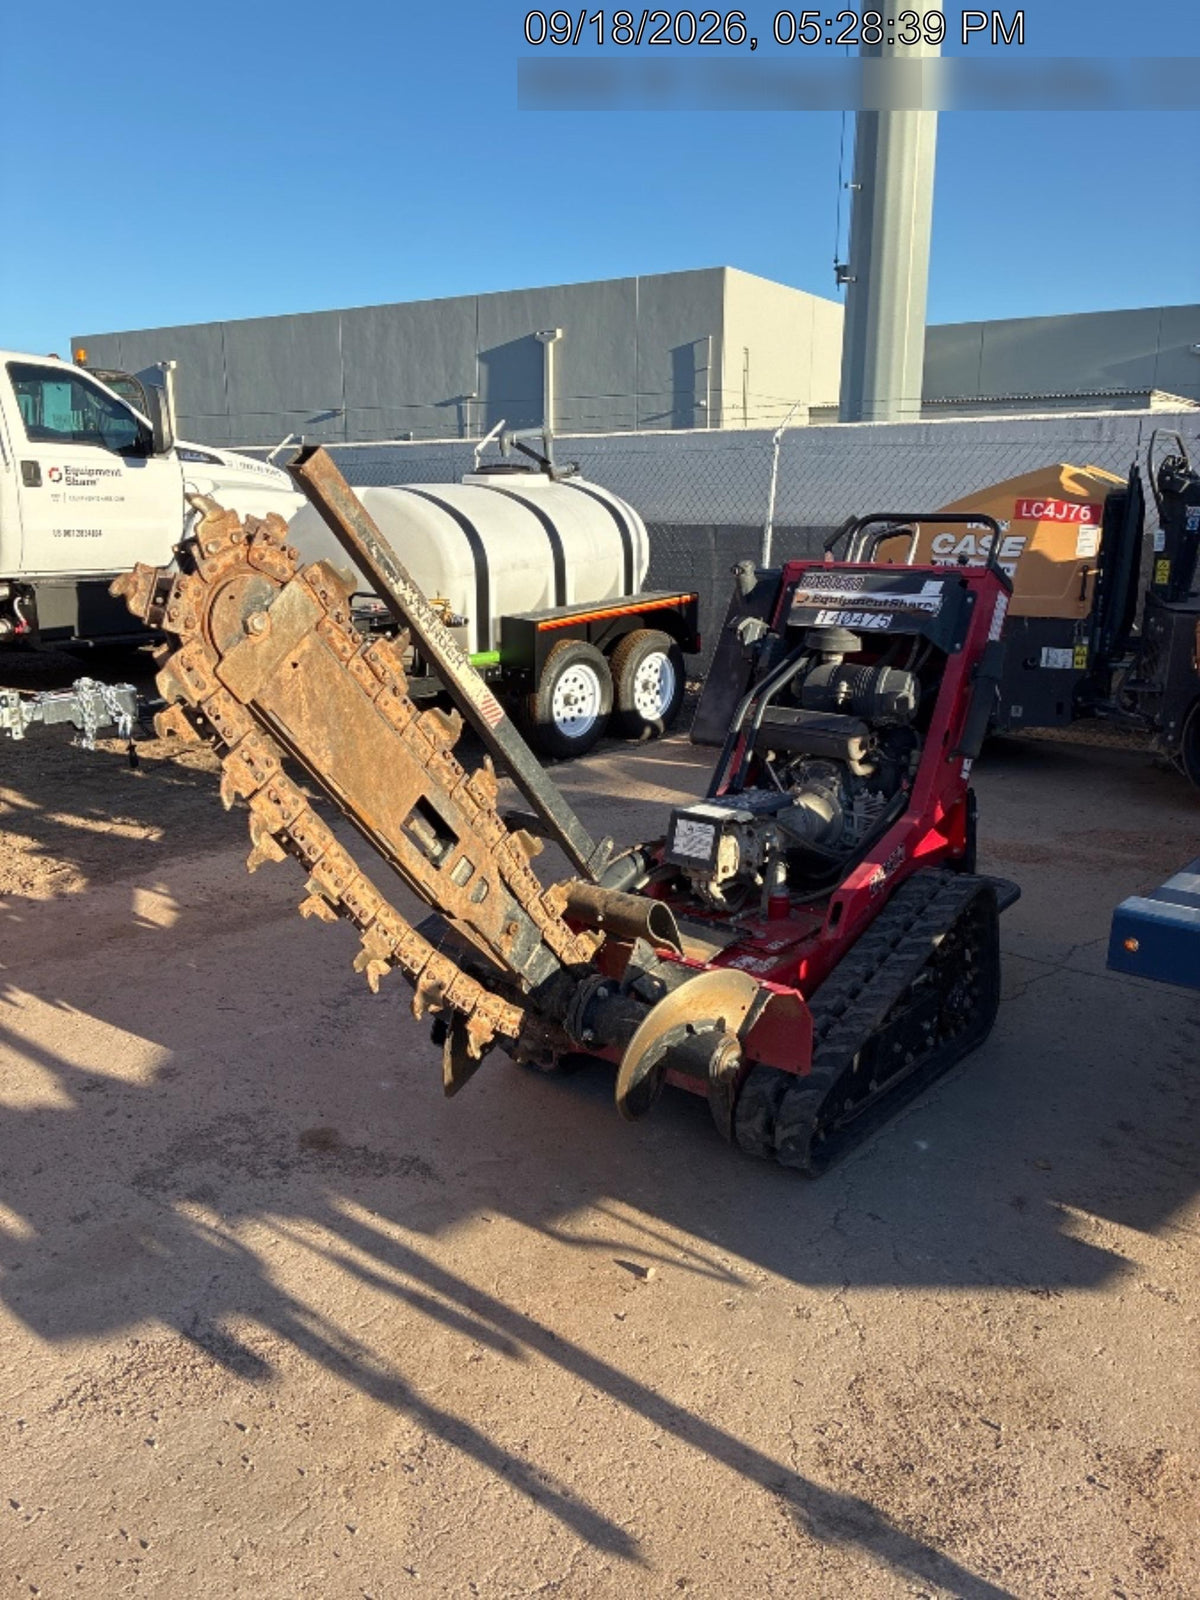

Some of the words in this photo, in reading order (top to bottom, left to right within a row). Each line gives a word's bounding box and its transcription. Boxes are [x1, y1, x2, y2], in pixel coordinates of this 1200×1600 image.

[64, 465, 122, 477] Equipment
[1021, 501, 1092, 520] LC4J76
[931, 532, 1028, 558] CASE
[820, 610, 891, 628] 140475
